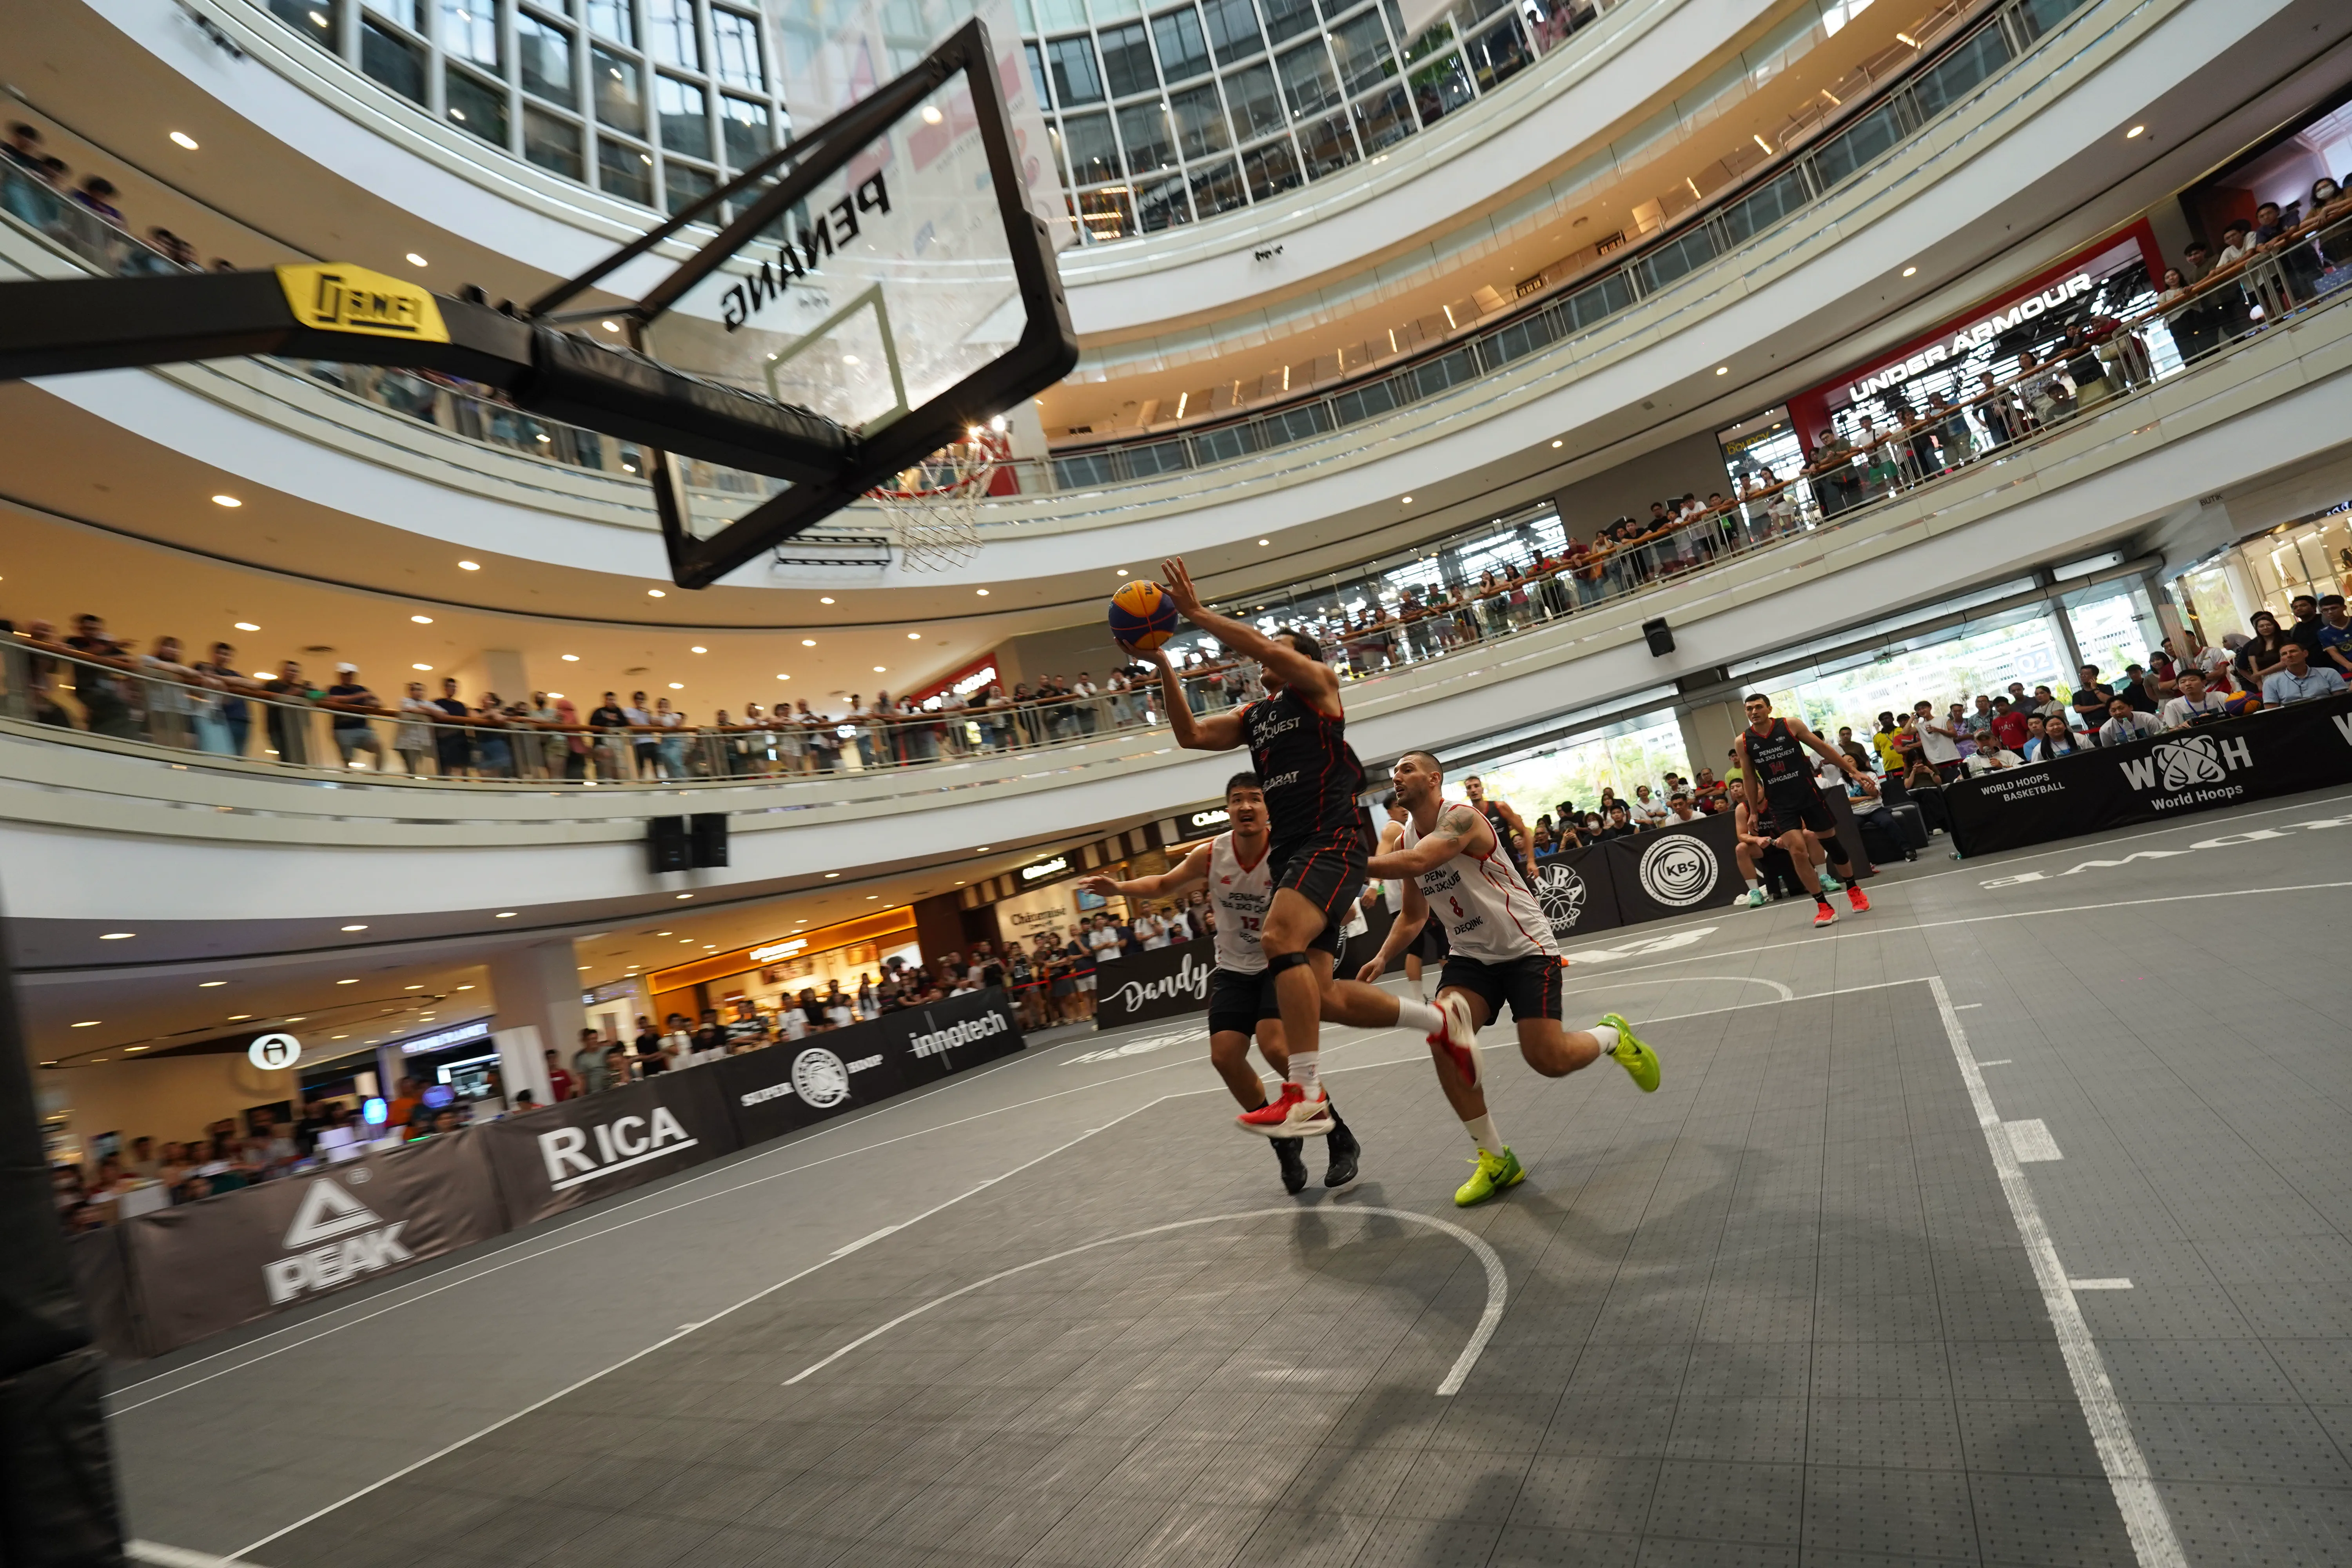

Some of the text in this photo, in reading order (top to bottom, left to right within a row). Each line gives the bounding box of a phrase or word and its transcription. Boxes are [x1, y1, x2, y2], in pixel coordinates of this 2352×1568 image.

[1849, 273, 2093, 402] UNDER ARMOUR
[2200, 493, 2223, 506] BUTIK
[1759, 746, 1783, 757] PENANG
[1777, 748, 1795, 758] QUEST
[1981, 773, 2050, 795] WORLD HOOPS
[2003, 782, 2065, 802] BASKETBALL
[2151, 785, 2244, 810] World Hoops
[1657, 836, 1674, 845] BELIA
[1685, 836, 1704, 847] SUKAN
[1666, 860, 1697, 877] KBS
[1240, 916, 1259, 931] 12
[1454, 916, 1483, 935] DEQING
[1100, 953, 1218, 1012] Dandy
[908, 1009, 1008, 1058] innotech
[537, 1107, 690, 1181] RICA
[261, 1220, 415, 1305] PEAK
